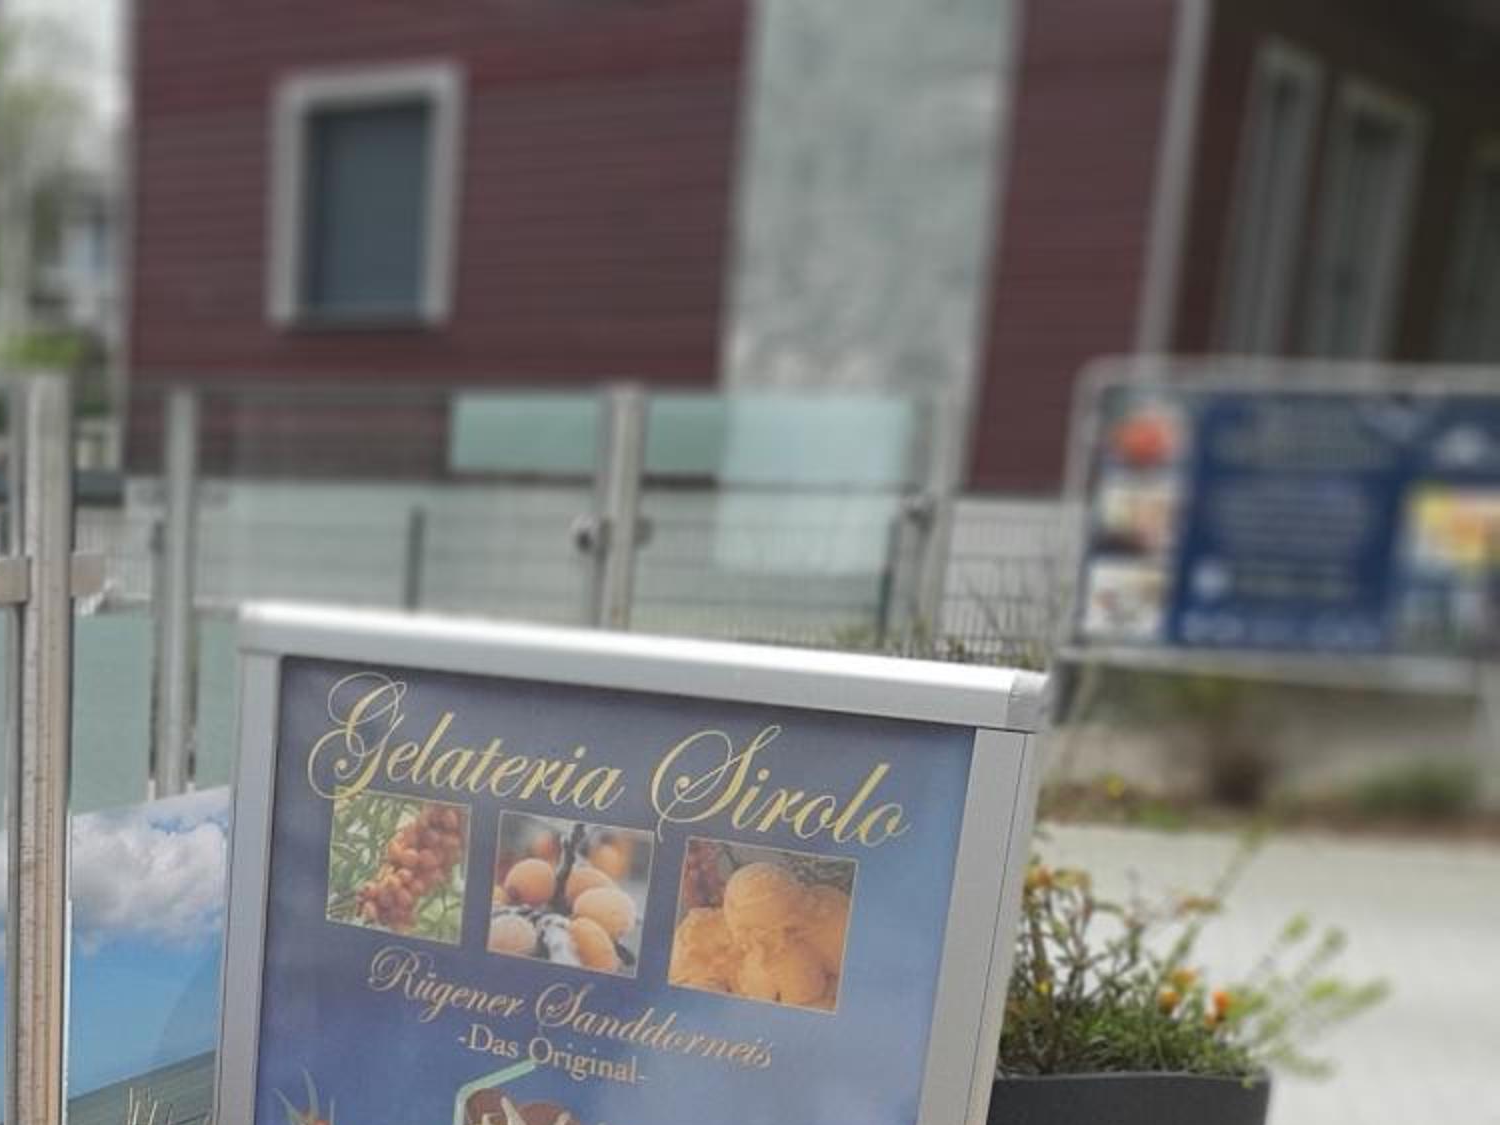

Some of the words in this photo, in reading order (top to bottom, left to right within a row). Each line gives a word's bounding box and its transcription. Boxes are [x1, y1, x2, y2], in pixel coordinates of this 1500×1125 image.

[307, 672, 624, 812] Gelateria
[651, 725, 911, 847] Sirolo
[367, 945, 525, 1023] Rügener
[535, 982, 774, 1070] Sanddorneis
